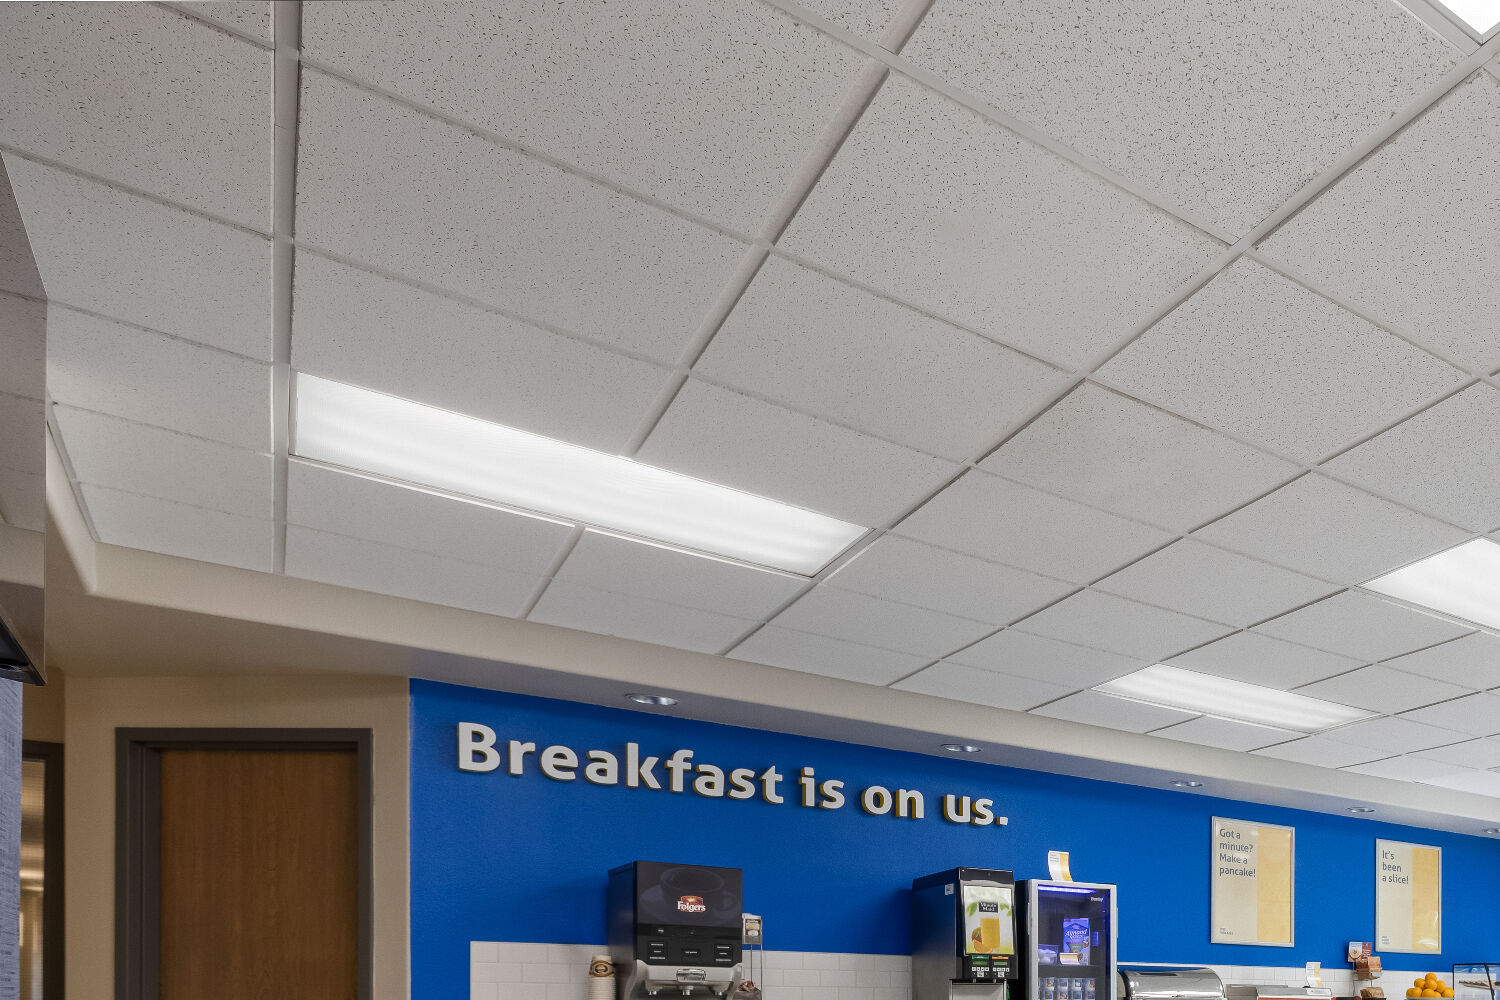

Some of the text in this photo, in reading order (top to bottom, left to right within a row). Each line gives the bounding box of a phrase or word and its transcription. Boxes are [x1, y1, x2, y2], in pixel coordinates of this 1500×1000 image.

[457, 721, 1009, 826] Breakfast is on us.
[1219, 828, 1234, 839] Got
[1219, 841, 1254, 853] minute?
[1219, 853, 1241, 864] Make
[1382, 849, 1395, 860] It's
[1219, 867, 1256, 878] pancake!
[1382, 861, 1402, 873] been
[1388, 874, 1409, 885] slice!
[677, 901, 706, 912] Folgers
